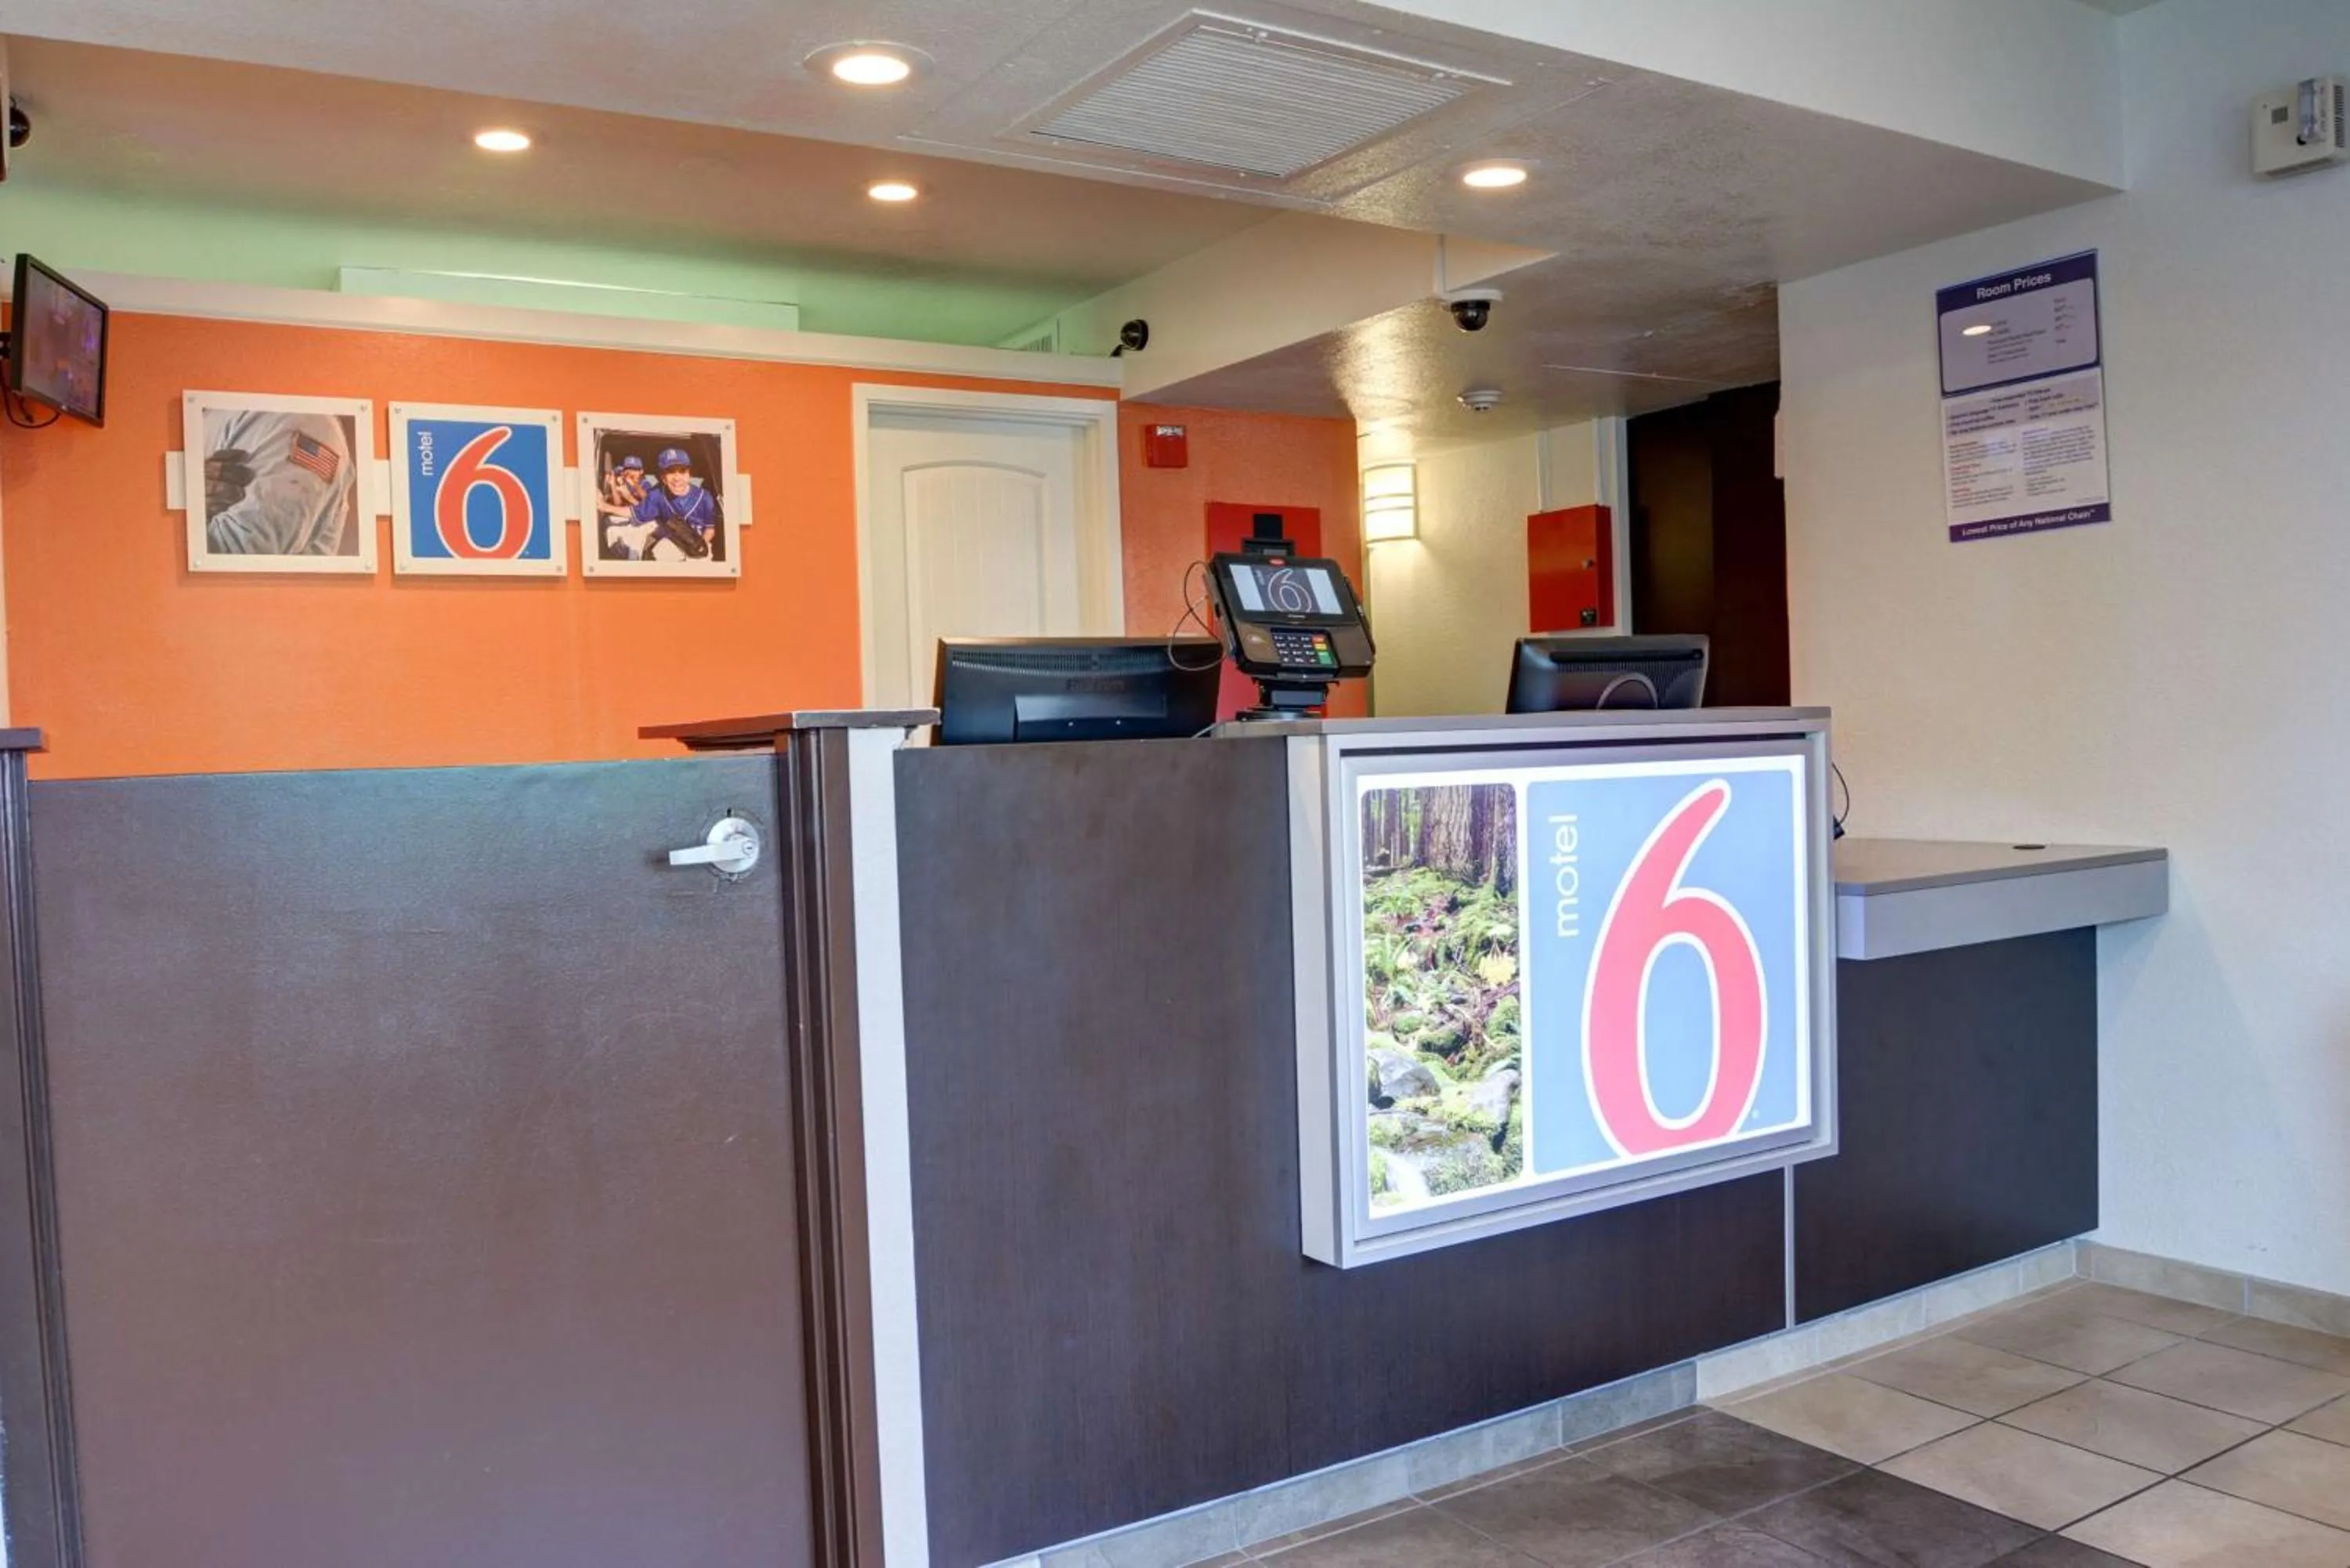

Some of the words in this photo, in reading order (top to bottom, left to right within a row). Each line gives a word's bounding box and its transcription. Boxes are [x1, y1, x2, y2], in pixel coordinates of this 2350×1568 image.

[1976, 283, 2011, 301] Room
[2014, 273, 2052, 291] Prices
[417, 432, 433, 476] motel
[434, 425, 533, 559] 6
[1548, 814, 1579, 938] motel
[1581, 778, 1768, 1162] 6
